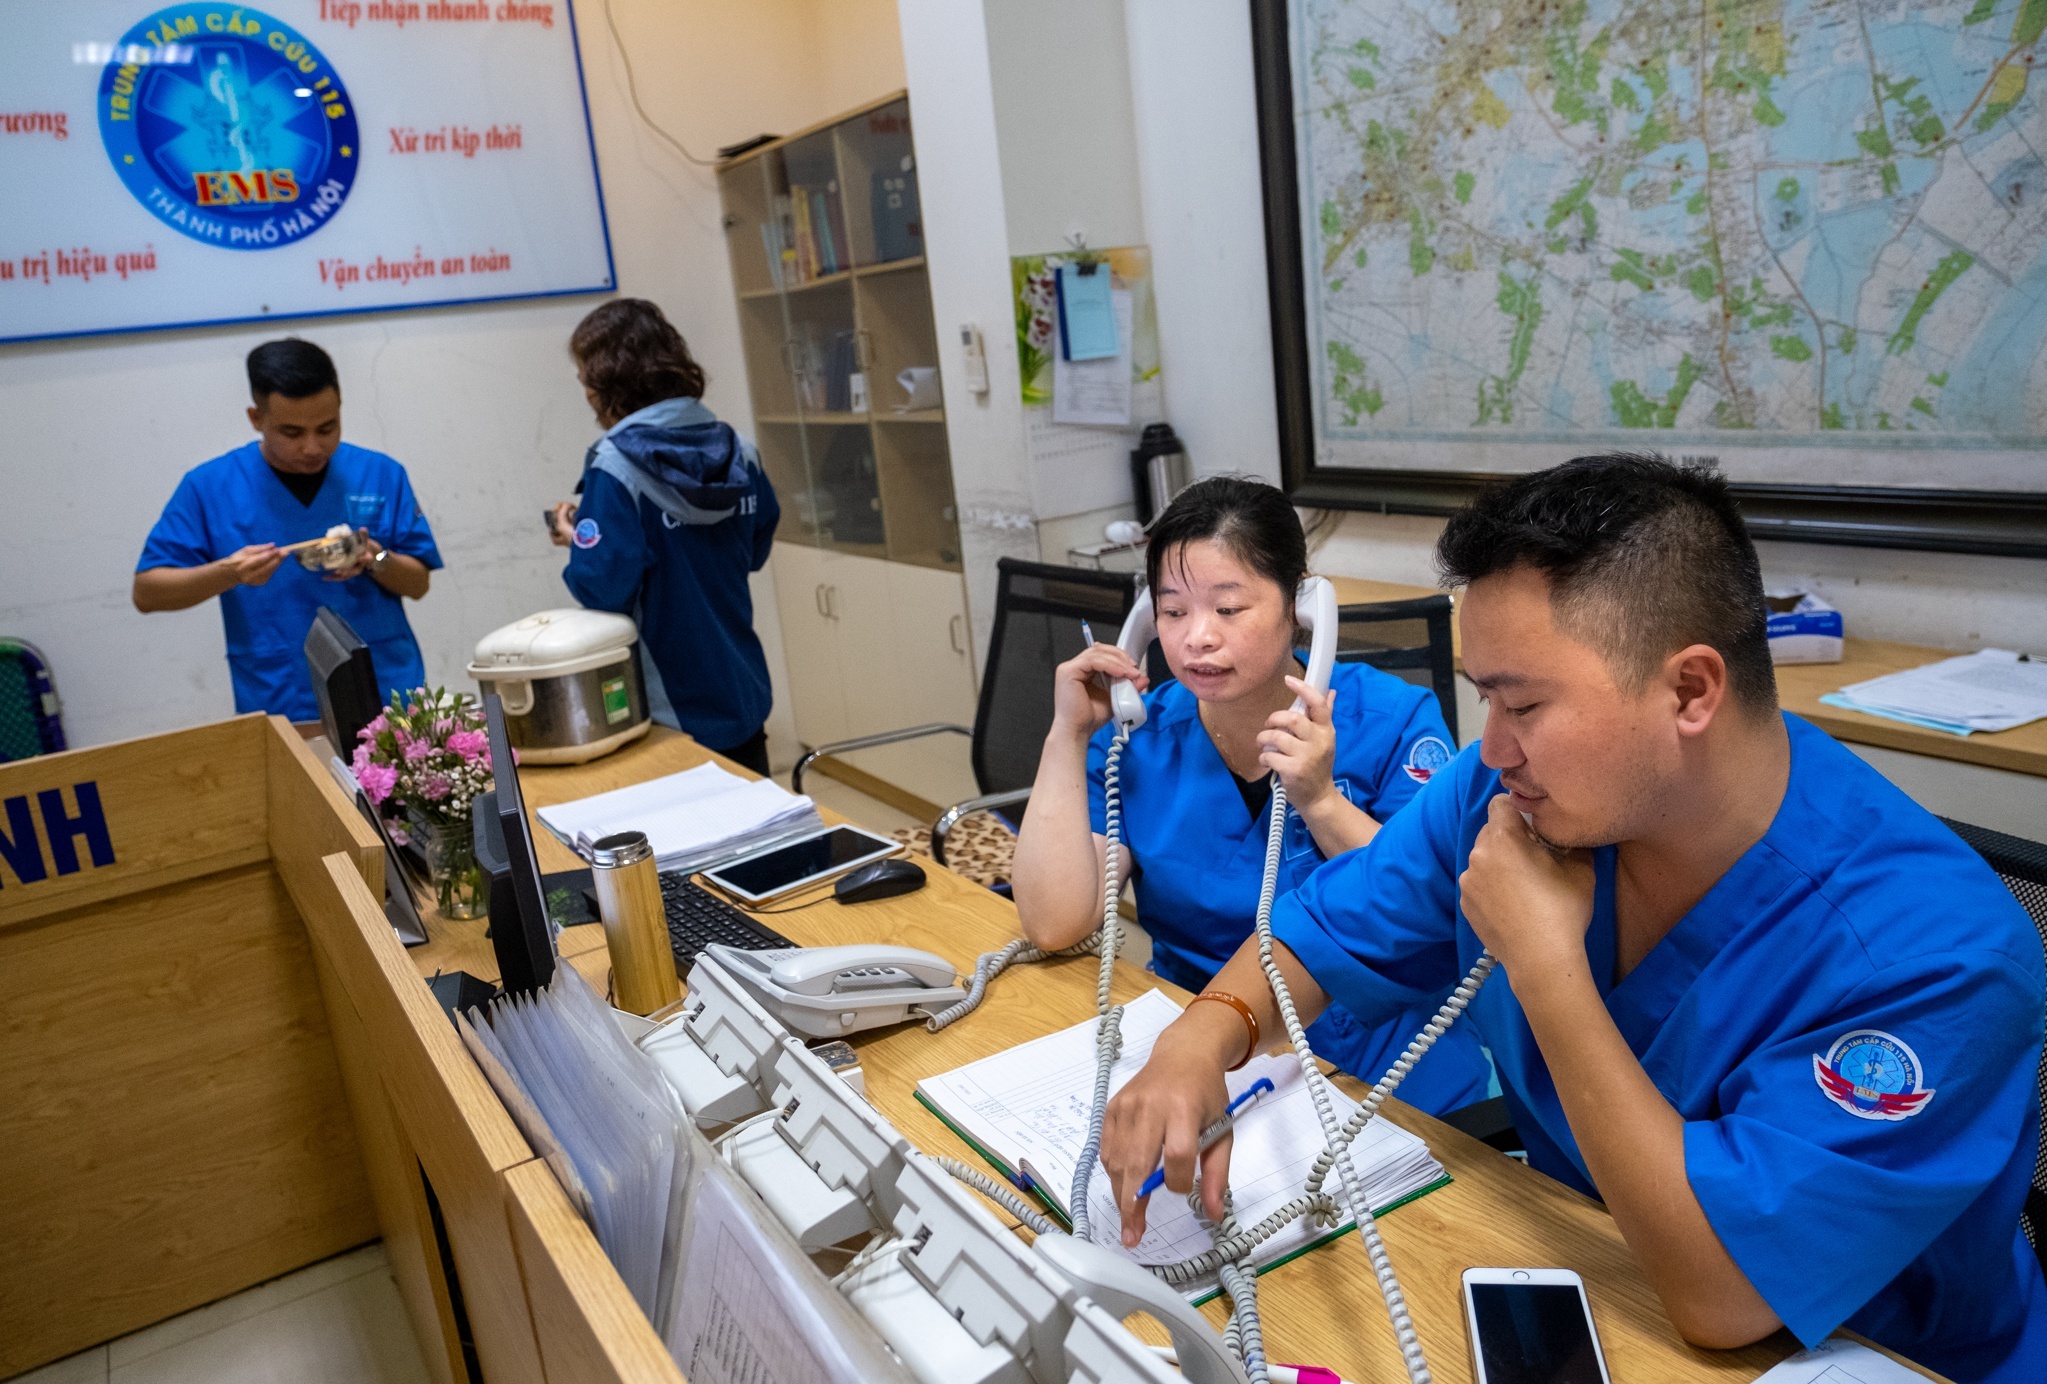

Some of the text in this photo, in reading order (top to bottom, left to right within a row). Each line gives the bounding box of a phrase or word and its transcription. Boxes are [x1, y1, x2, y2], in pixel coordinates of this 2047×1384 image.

[427, 0, 490, 21] nhanh
[206, 8, 261, 36] CẤP
[314, 76, 346, 119] 115
[452, 126, 480, 157] kịp
[486, 124, 522, 151] thời
[192, 168, 300, 207] EMS
[149, 178, 345, 244] THÀNH PHỐ HÀ NỘI
[22, 250, 49, 285] trị
[57, 248, 107, 282] hiệu
[115, 243, 156, 280] quả
[319, 245, 510, 291] Vận chuyển an toàn
[1834, 1046, 1849, 1064] TRUNG
[1849, 1038, 1863, 1048] TÂM
[1864, 1035, 1880, 1045] CẤP
[1881, 1040, 1895, 1052] CỨU
[1895, 1050, 1906, 1063] 115
[1903, 1062, 1912, 1072] HÀ
